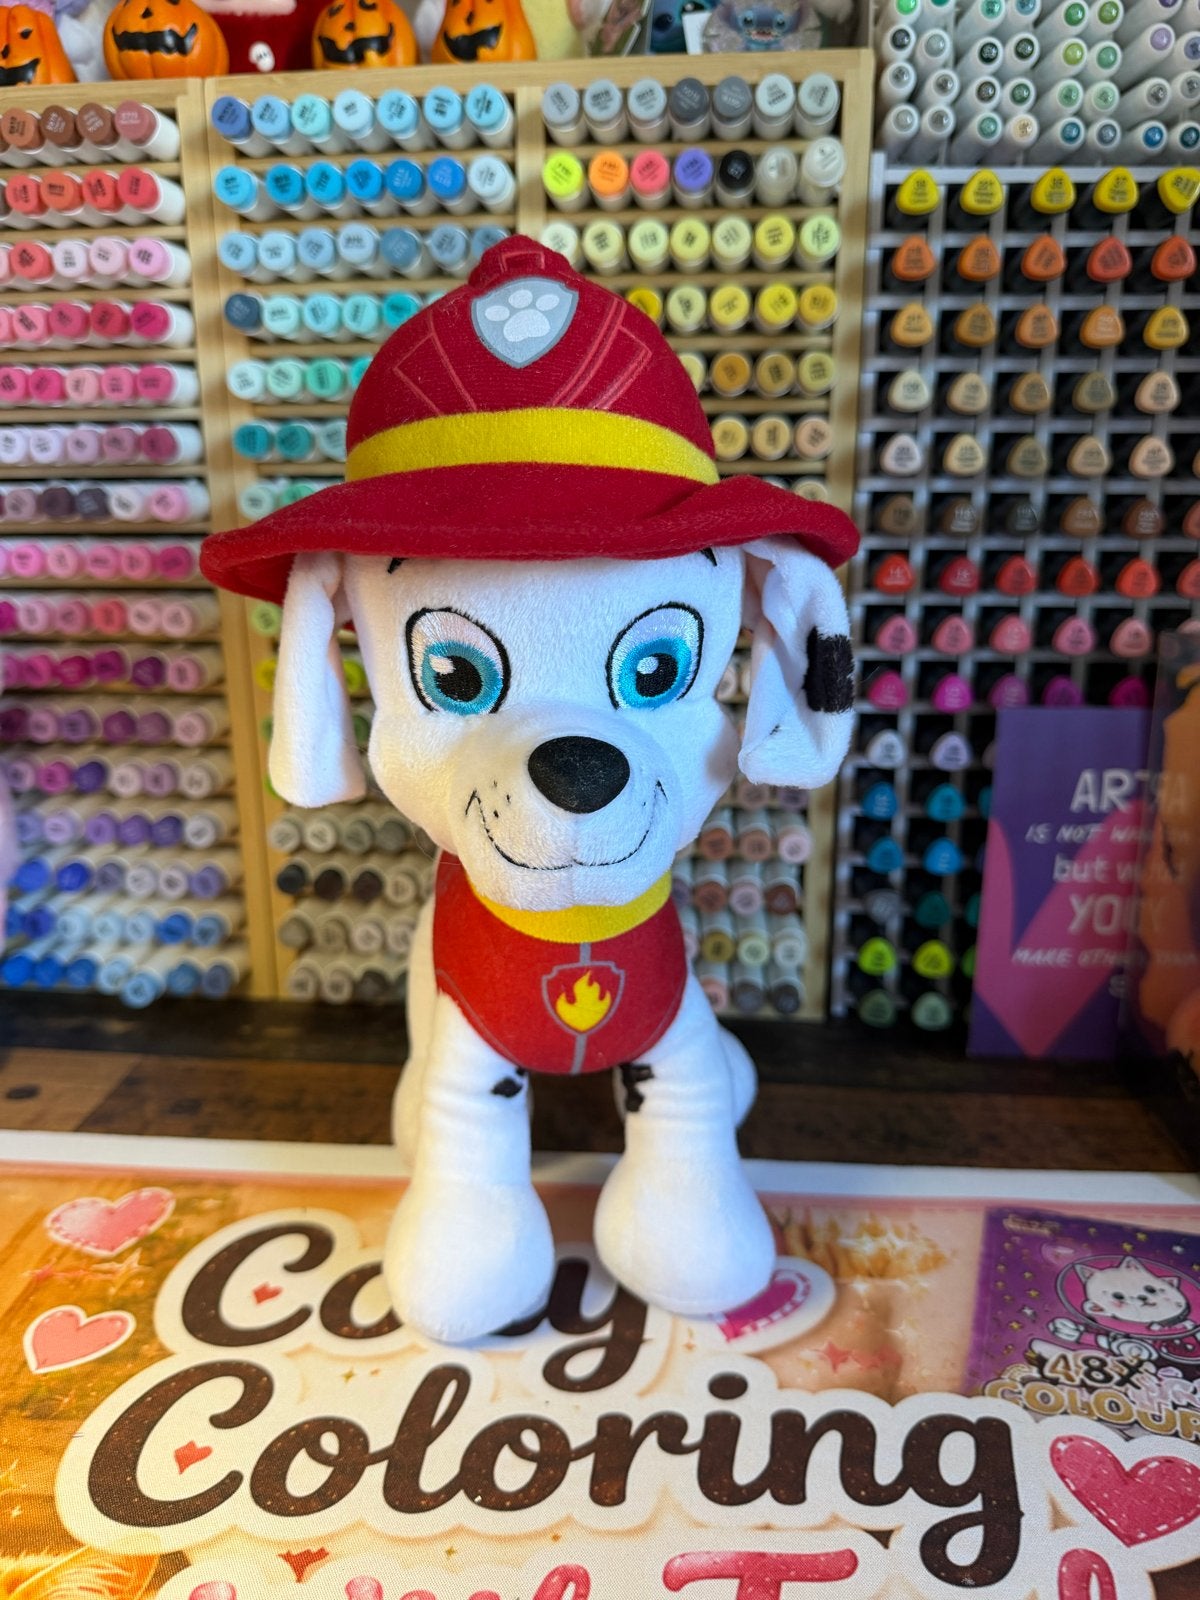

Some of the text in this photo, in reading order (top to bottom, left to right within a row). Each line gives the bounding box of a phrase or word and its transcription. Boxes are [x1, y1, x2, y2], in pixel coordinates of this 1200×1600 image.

[1025, 823, 1050, 845] IS
[1056, 822, 1104, 844] NOT
[1053, 852, 1111, 884] but
[1011, 946, 1074, 969] MAKE
[88, 1360, 1024, 1588] Coloring
